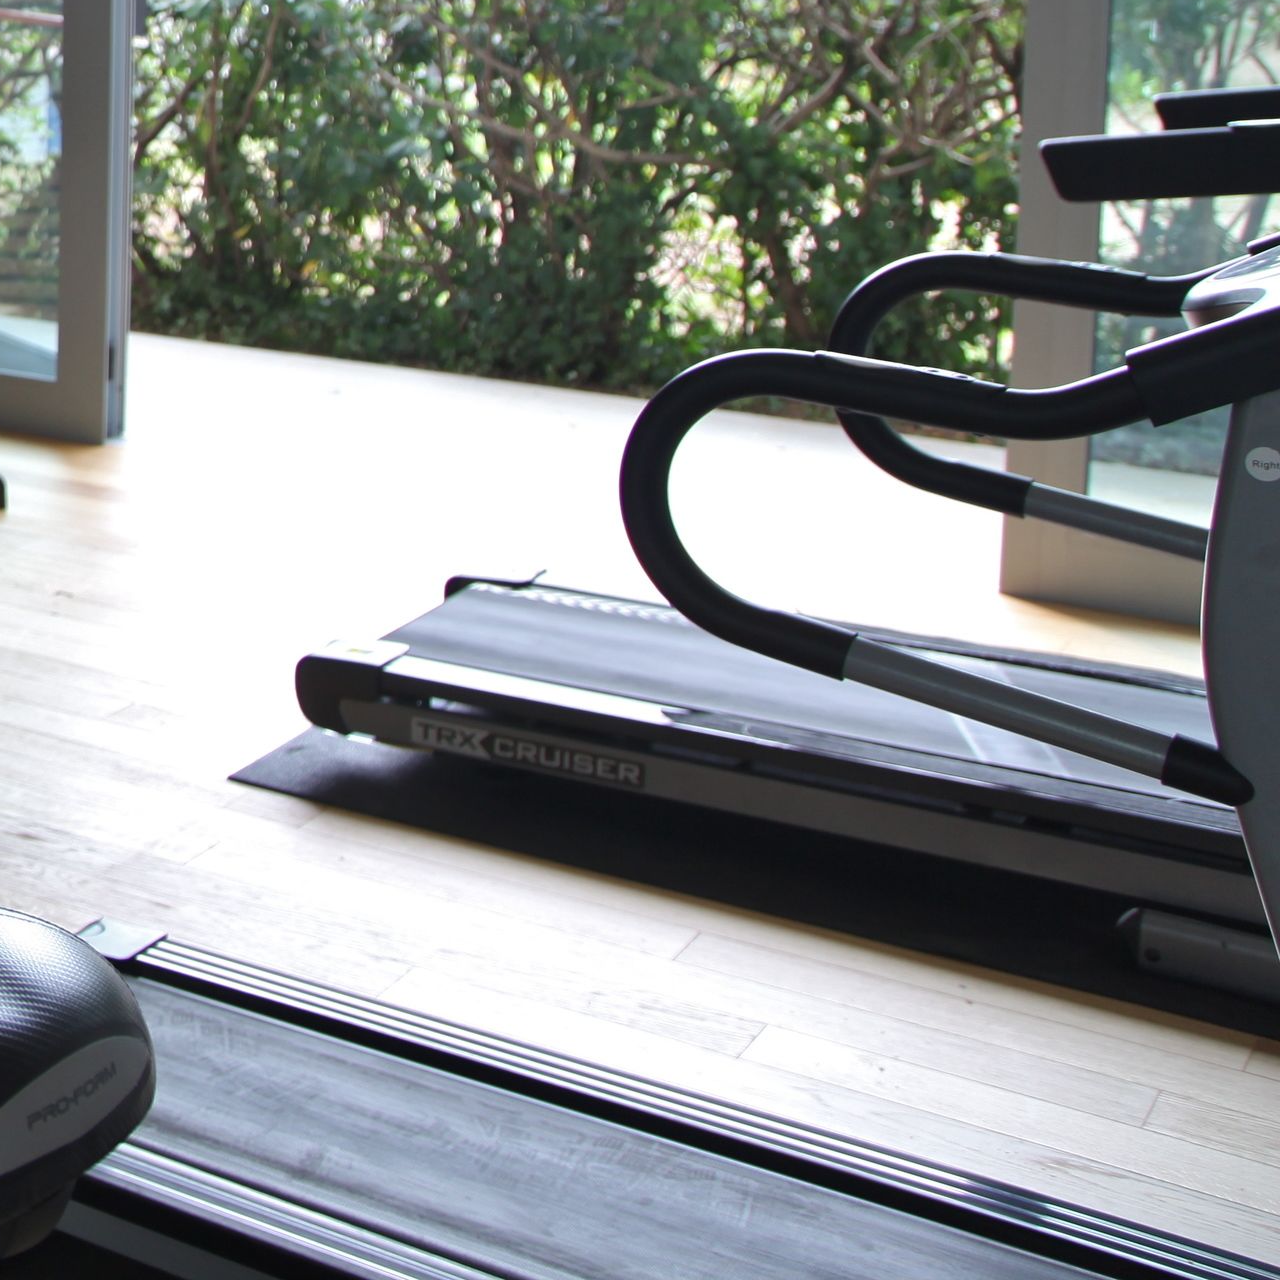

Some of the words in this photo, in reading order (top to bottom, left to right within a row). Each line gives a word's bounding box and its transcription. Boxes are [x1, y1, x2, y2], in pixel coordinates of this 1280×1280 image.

[418, 723, 478, 751] TRX
[494, 737, 641, 785] CRUISER
[27, 1061, 117, 1131] PRO-FORM
